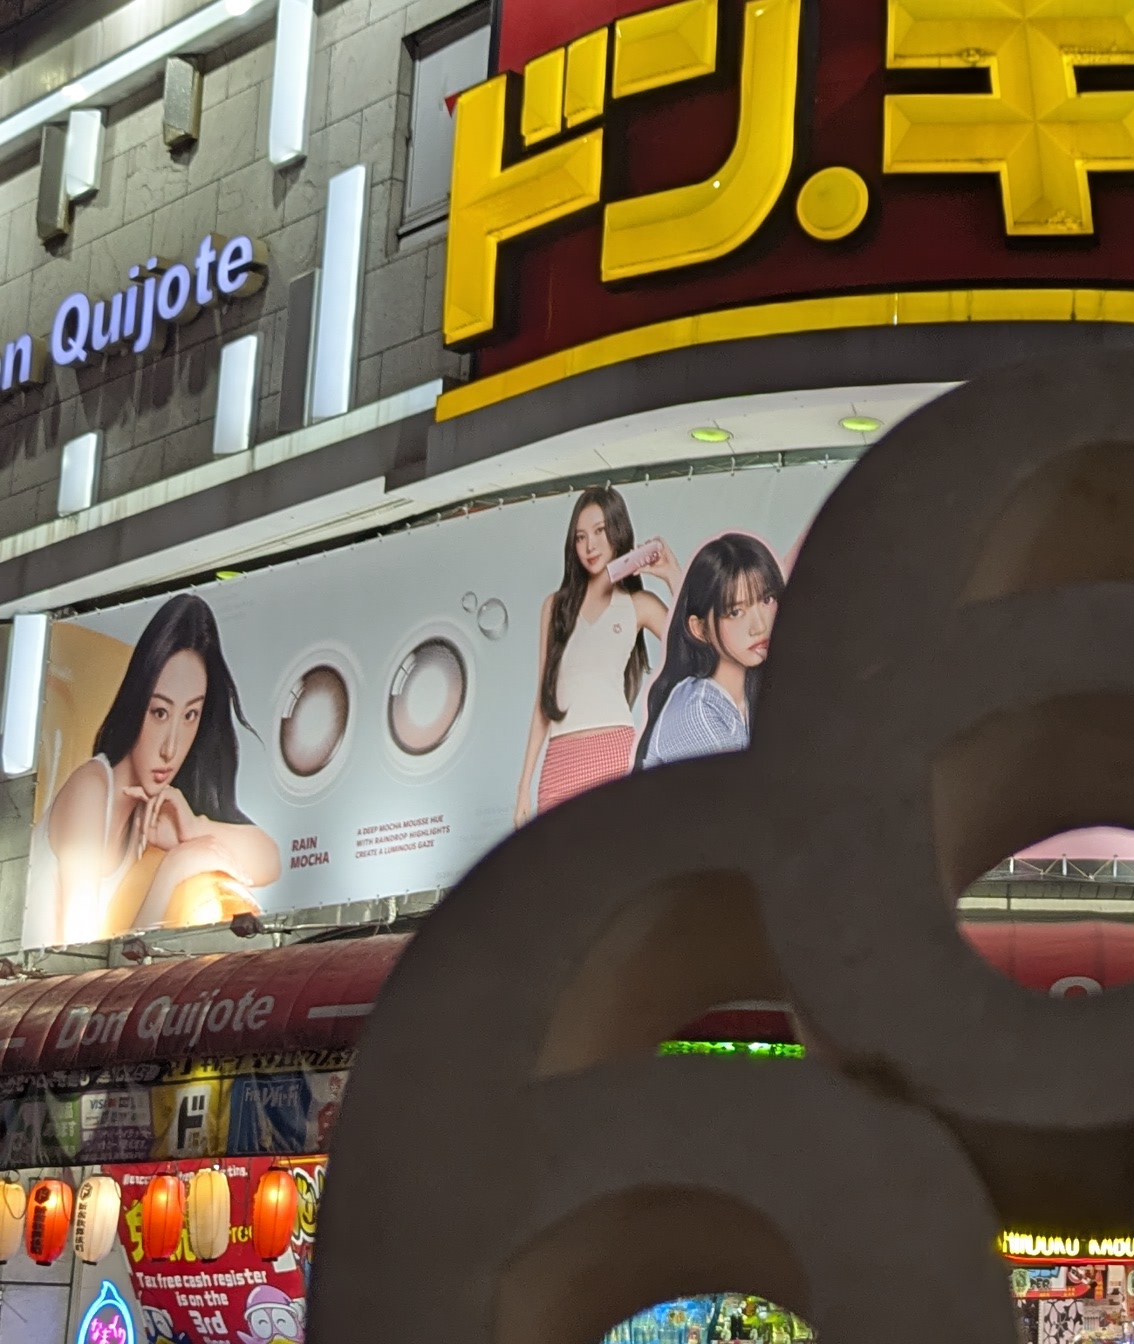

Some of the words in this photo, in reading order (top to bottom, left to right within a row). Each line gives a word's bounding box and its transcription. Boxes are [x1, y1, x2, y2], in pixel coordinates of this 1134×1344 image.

[53, 234, 254, 367] Quijote
[363, 825, 378, 835] DEEP
[379, 822, 401, 833] MOCHA
[403, 817, 429, 829] MOUSSE
[430, 814, 444, 824] HUE
[291, 836, 318, 853] RAIN
[356, 838, 374, 848] WITH
[374, 832, 408, 845] RAINDROP
[409, 825, 451, 839] HIGHLIGHTS
[290, 851, 330, 869] MOCHA
[355, 849, 378, 859] CREATE
[384, 842, 417, 855] LUMINOUS
[417, 839, 435, 850] GAZE
[57, 1006, 128, 1049] Don
[137, 988, 275, 1047] Quijote
[262, 1084, 299, 1107] Wi-Fi
[998, 1230, 1080, 1256] HINJUKU
[136, 1273, 157, 1289] Tax
[156, 1272, 183, 1288] free
[183, 1271, 212, 1288] cash
[212, 1268, 267, 1288] register
[174, 1291, 188, 1307] is
[188, 1294, 203, 1307] on
[203, 1290, 229, 1306] the
[188, 1310, 229, 1335] 3rd
